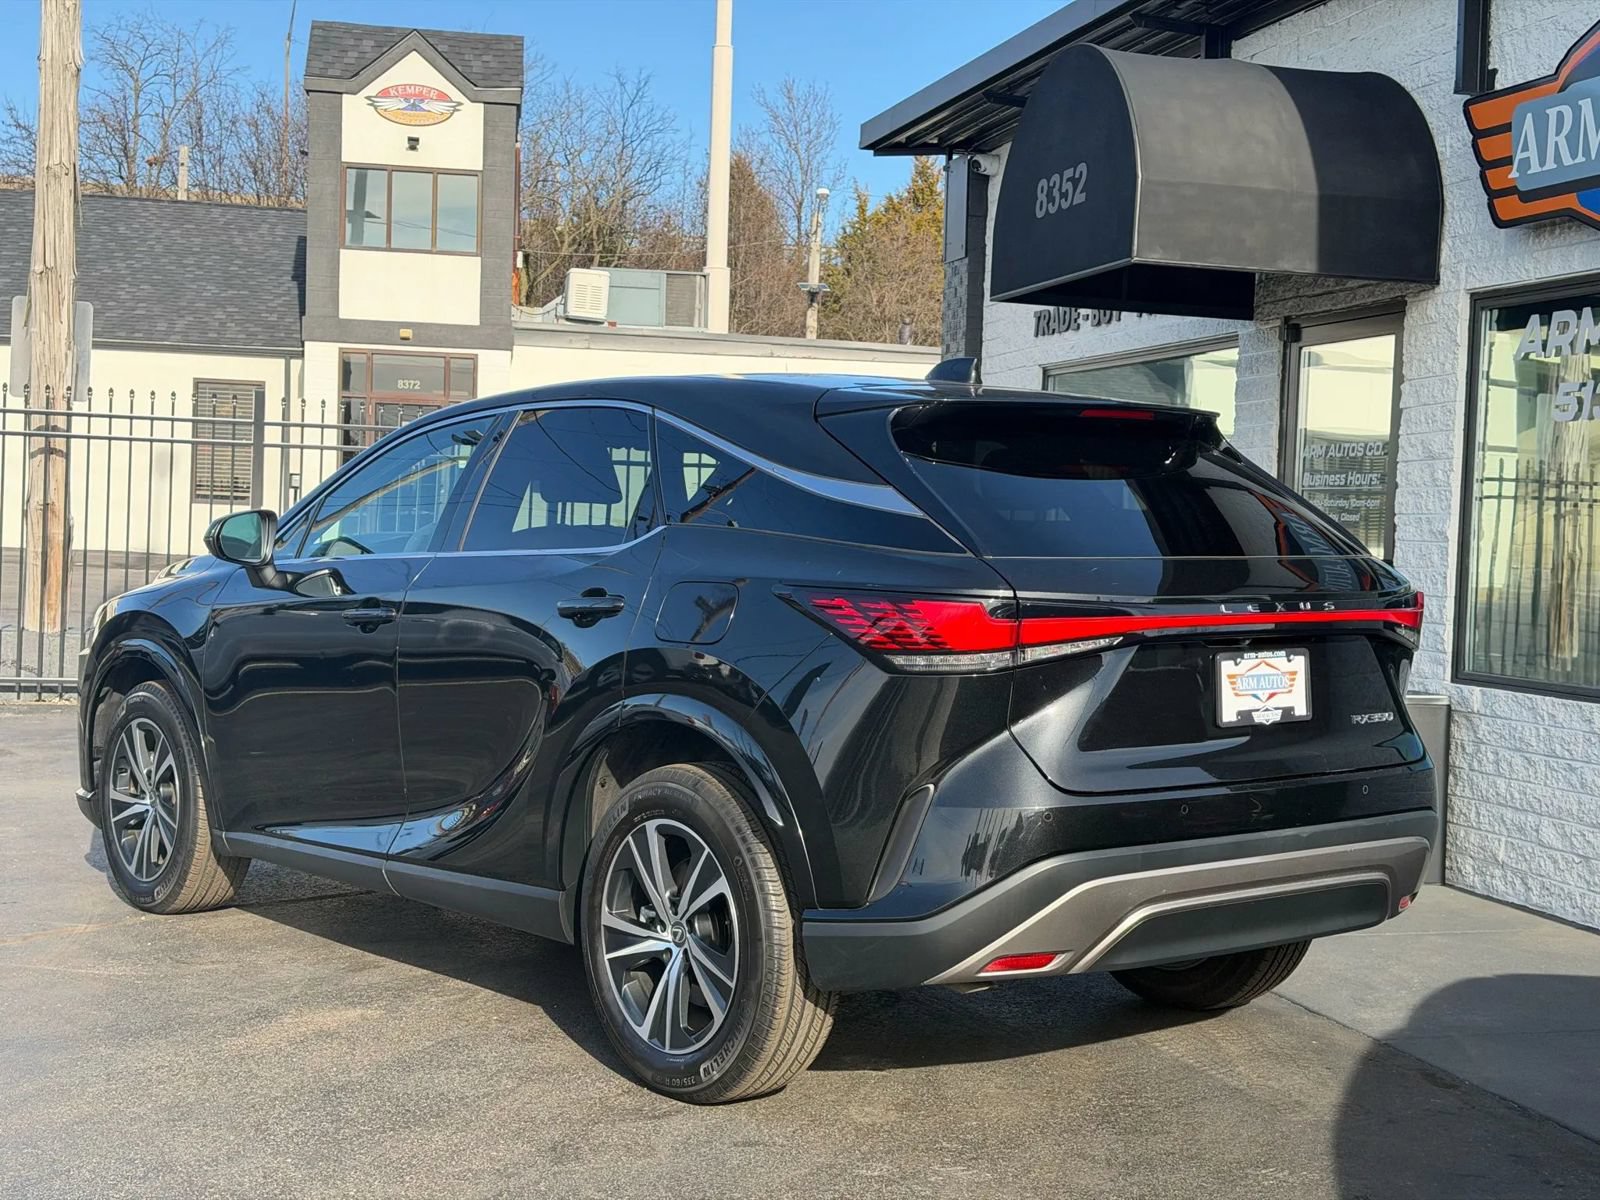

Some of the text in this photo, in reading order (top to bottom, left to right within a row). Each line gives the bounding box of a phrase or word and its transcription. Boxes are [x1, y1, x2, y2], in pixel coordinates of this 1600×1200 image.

[389, 86, 438, 100] KEMPER
[1508, 97, 1600, 178] ARM
[1035, 162, 1088, 218] 8352
[397, 379, 421, 390] 8372
[1551, 380, 1600, 422] 51
[1302, 442, 1384, 459] ARM AUTOS CO.
[1302, 471, 1381, 487] Business Hours:
[1220, 602, 1336, 614] LEXUS
[1236, 674, 1291, 691] ARM AUTOS
